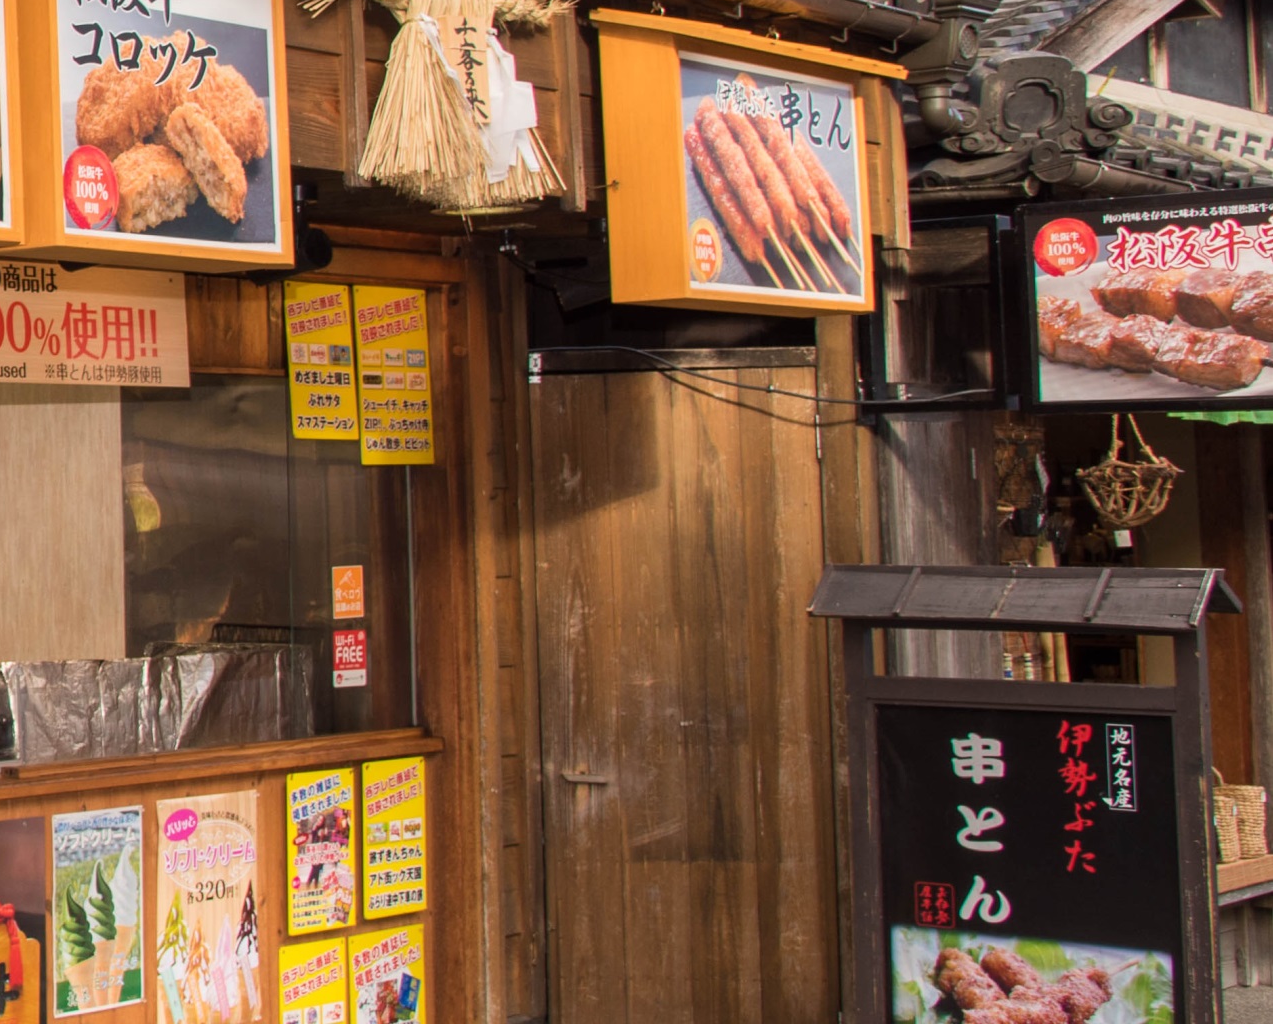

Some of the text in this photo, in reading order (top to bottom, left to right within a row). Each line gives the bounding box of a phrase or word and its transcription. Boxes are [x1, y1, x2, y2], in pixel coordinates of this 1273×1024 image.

[71, 22, 219, 91] コロッケ
[715, 79, 851, 151] 伊勢ぶた 串とん
[76, 165, 105, 181] 松阪牛
[74, 180, 109, 203] 100%
[83, 201, 101, 215] 使用
[1047, 242, 1086, 256] 100%
[1050, 232, 1080, 242] 松阪牛
[695, 245, 716, 261] 100%
[287, 293, 342, 318] 各テレビ番組で
[358, 296, 418, 323] 各テレビ番組で
[295, 372, 351, 386] めざまし土曜日
[297, 416, 354, 430] スマステーション
[336, 646, 363, 663] FREE
[1110, 727, 1133, 809] 地元名産
[291, 775, 341, 805] 多数の雑誌に
[365, 765, 418, 799] 各テレビ番組で
[1057, 721, 1097, 874] 伊勢ぶた
[57, 830, 137, 850] ソフトクリーム
[951, 733, 1011, 923] 串とん
[163, 841, 255, 874] ソフトクリーム
[187, 879, 235, 905] 各320円
[352, 931, 409, 972] 多数の雑誌に
[282, 947, 340, 985] 各テレビ番組で
